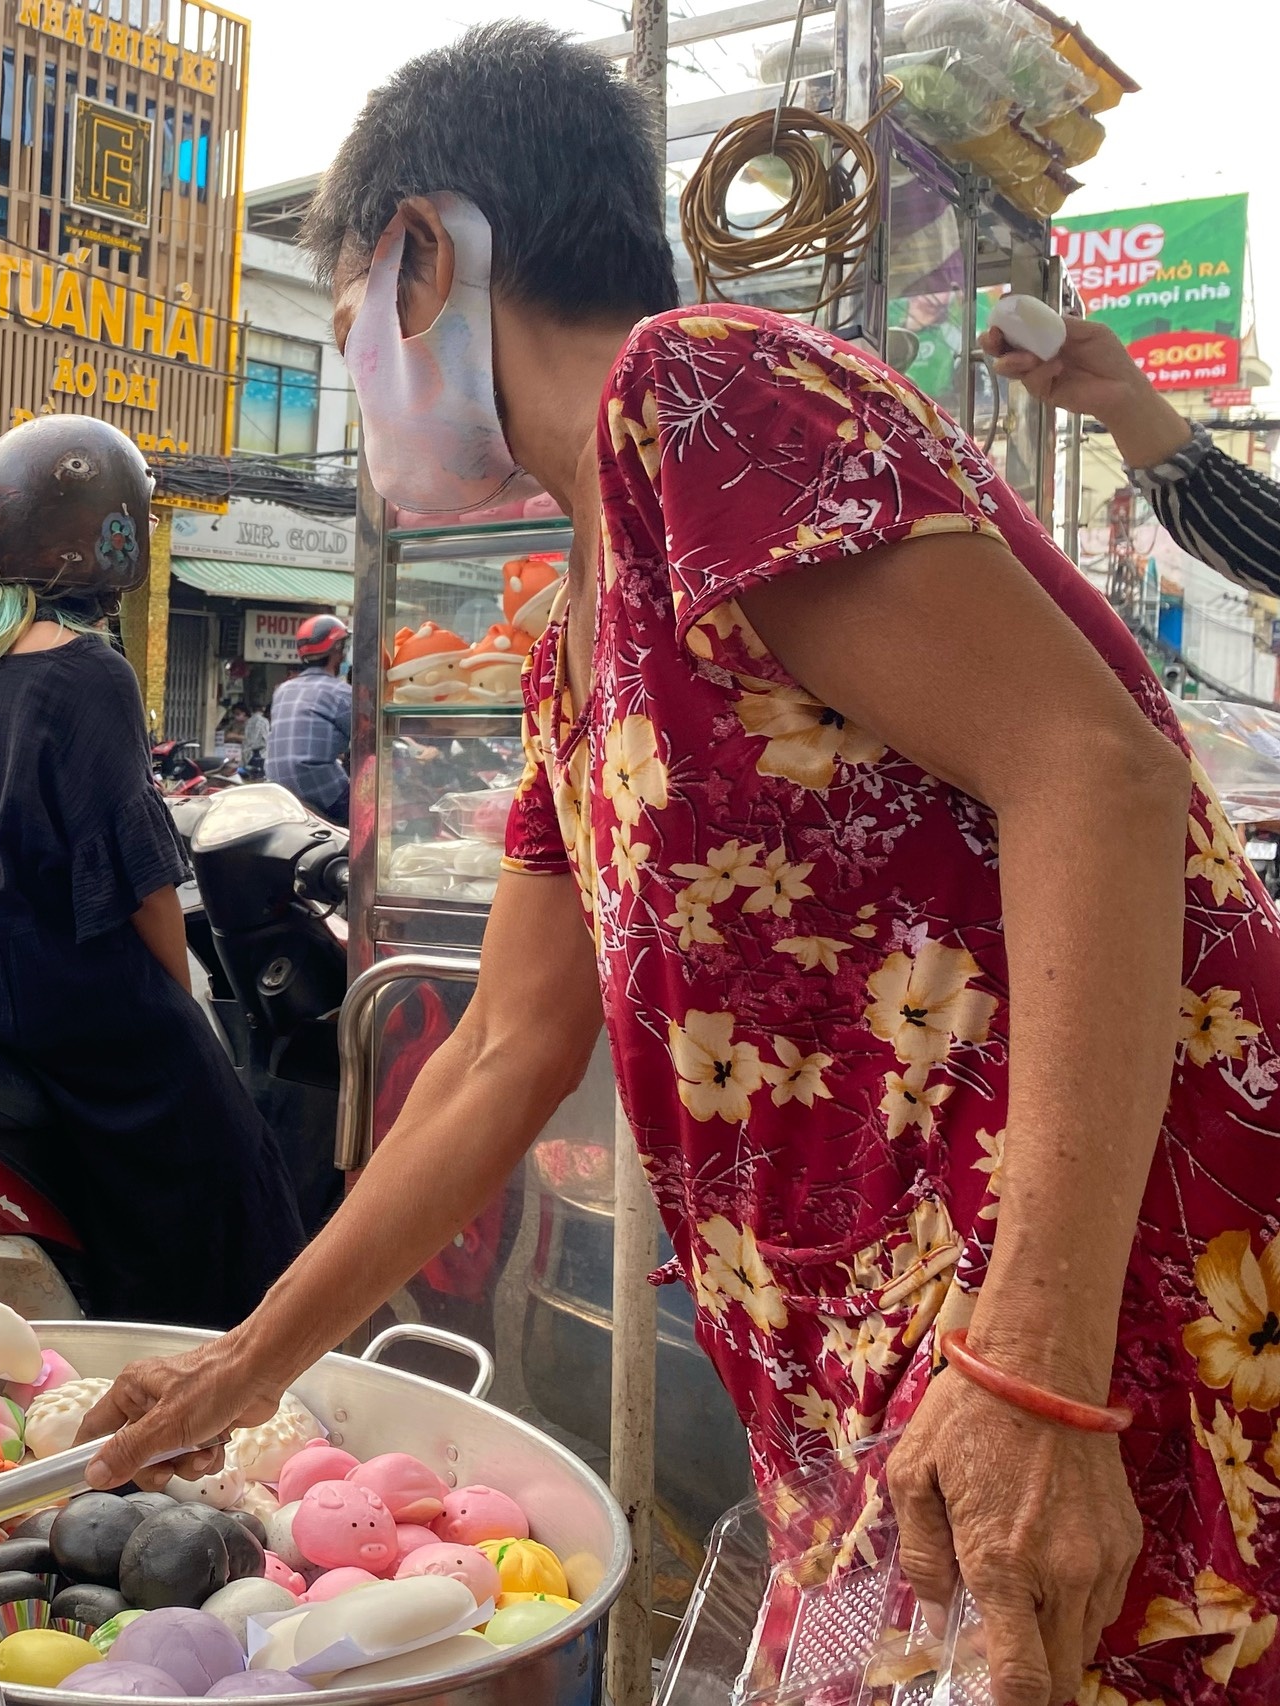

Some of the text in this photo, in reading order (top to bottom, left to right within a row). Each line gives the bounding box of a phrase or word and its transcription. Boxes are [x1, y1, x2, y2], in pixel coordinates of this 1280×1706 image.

[1198, 260, 1231, 278] RA
[1088, 281, 1231, 311] cho mọi nhà
[131, 281, 215, 368] HẢI
[1147, 340, 1227, 368] 300K
[54, 350, 160, 412] ÁO DÀI
[236, 521, 348, 555] MR. GOLD
